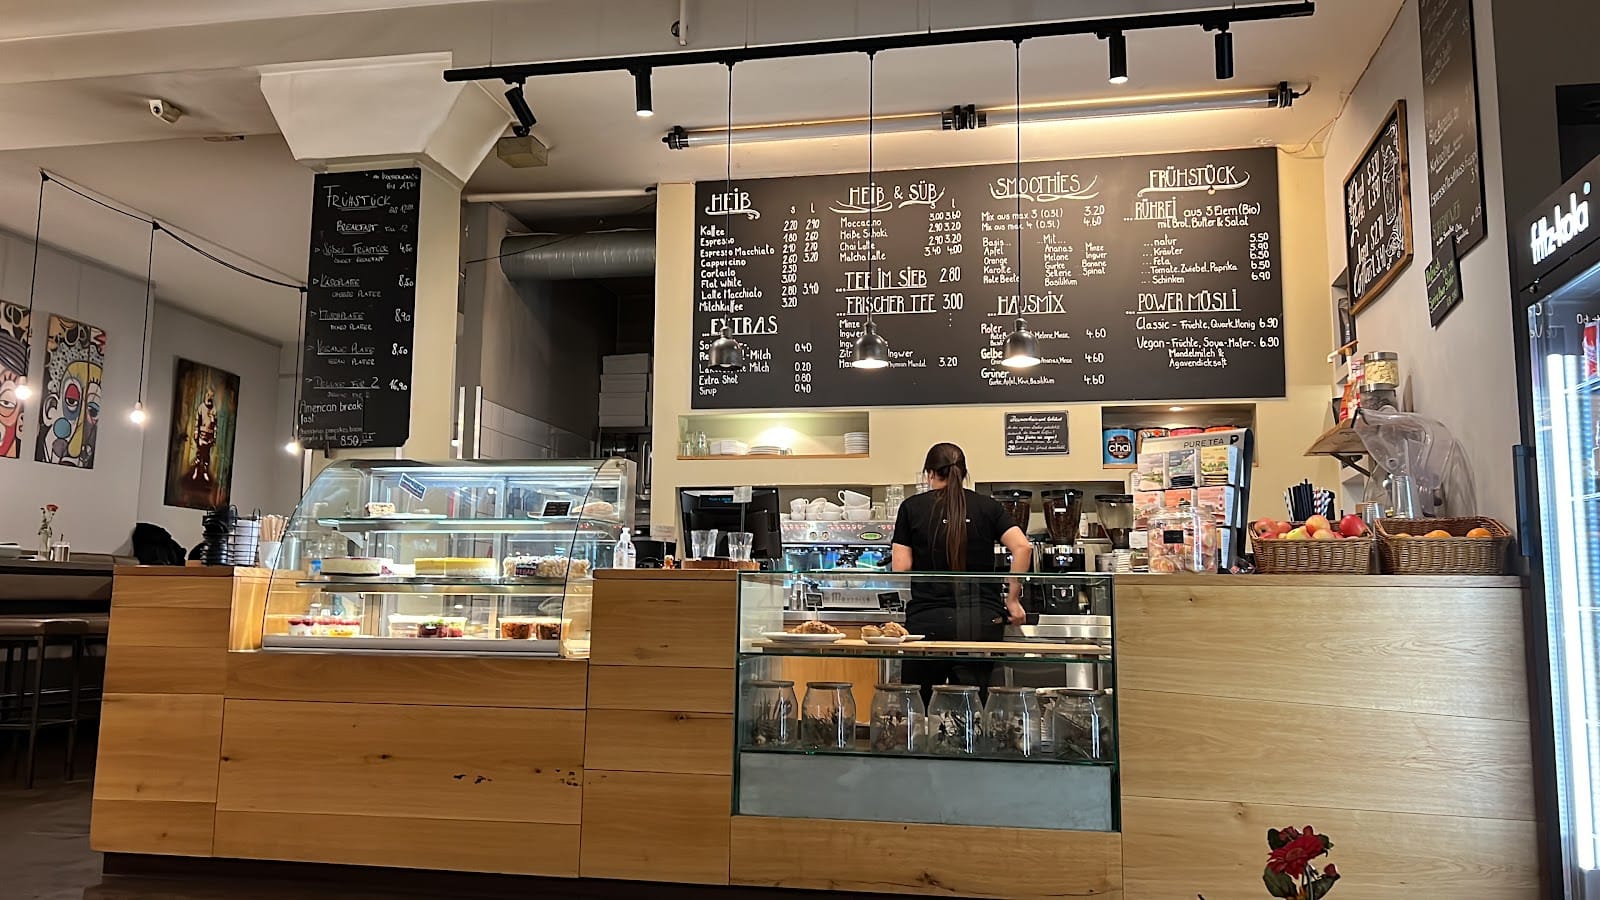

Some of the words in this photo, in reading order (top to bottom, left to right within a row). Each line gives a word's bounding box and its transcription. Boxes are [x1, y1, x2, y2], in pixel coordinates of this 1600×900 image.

[1149, 164, 1239, 189] FRÜHSTÜCK
[996, 171, 1081, 196] SMOOTHIES
[894, 186, 903, 200] &
[981, 211, 995, 222] Mix
[997, 212, 1011, 221] aus
[1031, 209, 1038, 219] 3
[1183, 208, 1202, 218] aus
[1205, 205, 1214, 217] 3
[1214, 204, 1238, 216] Eiern
[1238, 202, 1261, 216] (Bio)
[981, 222, 993, 232] Mix
[994, 223, 1006, 231] aus
[1026, 221, 1033, 229] 4
[1157, 219, 1171, 229] mit
[1191, 218, 1215, 229] Butter
[1216, 217, 1224, 227] &
[1224, 216, 1249, 227] Salat
[1530, 192, 1590, 265] fritz-kola
[700, 225, 725, 237] Kaffee
[700, 237, 735, 248] Espresso
[1249, 232, 1270, 243] 5.50
[700, 248, 733, 259] Espresso
[734, 244, 775, 257] Macchiato
[840, 241, 857, 251] Chai
[984, 246, 1004, 257] Apfel
[1045, 244, 1073, 254] Ananas
[1085, 242, 1105, 252] Minze
[1249, 241, 1270, 251] 5.90
[840, 251, 866, 262] Matcha
[984, 256, 1008, 266] Orange
[1044, 253, 1069, 261] Melone
[1085, 251, 1108, 260] Ingwer
[1249, 250, 1270, 260] 6.50
[700, 258, 747, 269] Cappuccino
[1045, 261, 1066, 270] Gurke
[1081, 259, 1107, 268] Banane
[1210, 261, 1238, 273] Paprika
[1250, 260, 1271, 270] 6.50
[898, 266, 928, 287] SIEB
[939, 266, 961, 282] 2.80
[1082, 267, 1106, 277] Spinat
[1251, 270, 1271, 281] 6.90
[701, 278, 718, 289] Flat
[720, 277, 742, 288] white
[983, 275, 999, 284] Rote
[1000, 273, 1019, 283] Beete
[1045, 277, 1078, 287] Basilikum
[701, 289, 722, 301] Latte
[723, 286, 763, 300] Macchiato
[910, 294, 937, 313] TEE
[1187, 288, 1239, 312] MÜSLI
[840, 319, 860, 328] Minze
[1136, 317, 1170, 330] Classic
[1234, 318, 1256, 331] Honig
[1259, 317, 1279, 329] 6.90
[981, 322, 1003, 334] Roter
[1086, 327, 1107, 339] 4.60
[1136, 336, 1165, 350] Vegan
[1259, 336, 1280, 348] 6.90
[887, 349, 914, 359] Ingwer
[1084, 353, 1104, 364] 4.60
[1168, 347, 1216, 359] Mandelmilch
[1217, 347, 1225, 358] &
[749, 362, 770, 373] Milch
[1168, 358, 1228, 370] Agavendicksaft
[699, 375, 720, 387] Extra
[721, 373, 739, 385] Shot
[981, 368, 1010, 379] Grüner
[1083, 374, 1105, 385] 4.60
[699, 386, 717, 397] Sirup
[1183, 439, 1207, 449] PURE
[1208, 437, 1225, 447] TEA
